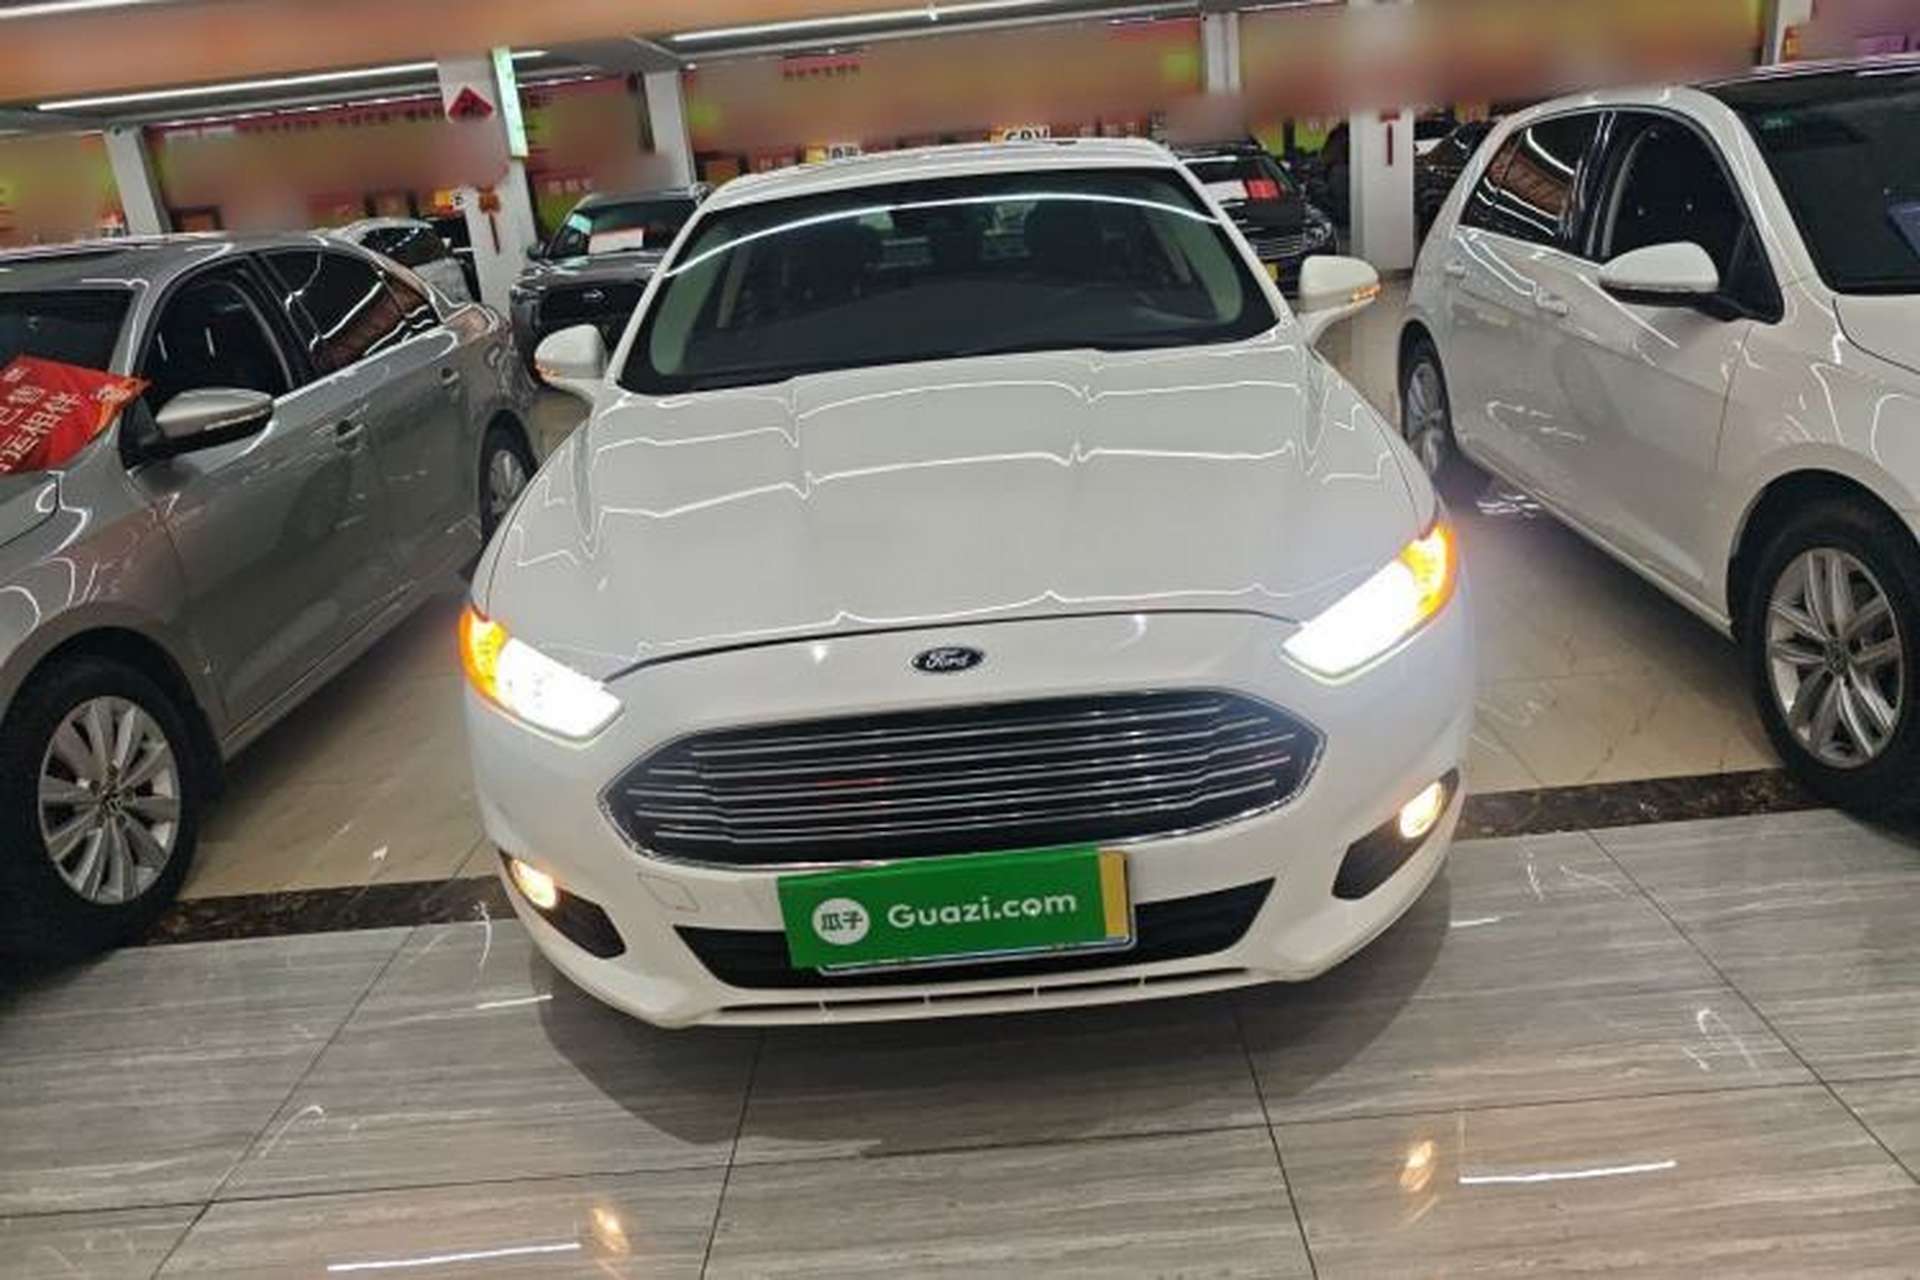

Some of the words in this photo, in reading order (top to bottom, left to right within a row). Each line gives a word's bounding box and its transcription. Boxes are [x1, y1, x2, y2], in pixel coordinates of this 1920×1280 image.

[925, 650, 969, 669] Ford
[887, 891, 1077, 928] Guazi.com
[821, 911, 863, 931] 瓜子
